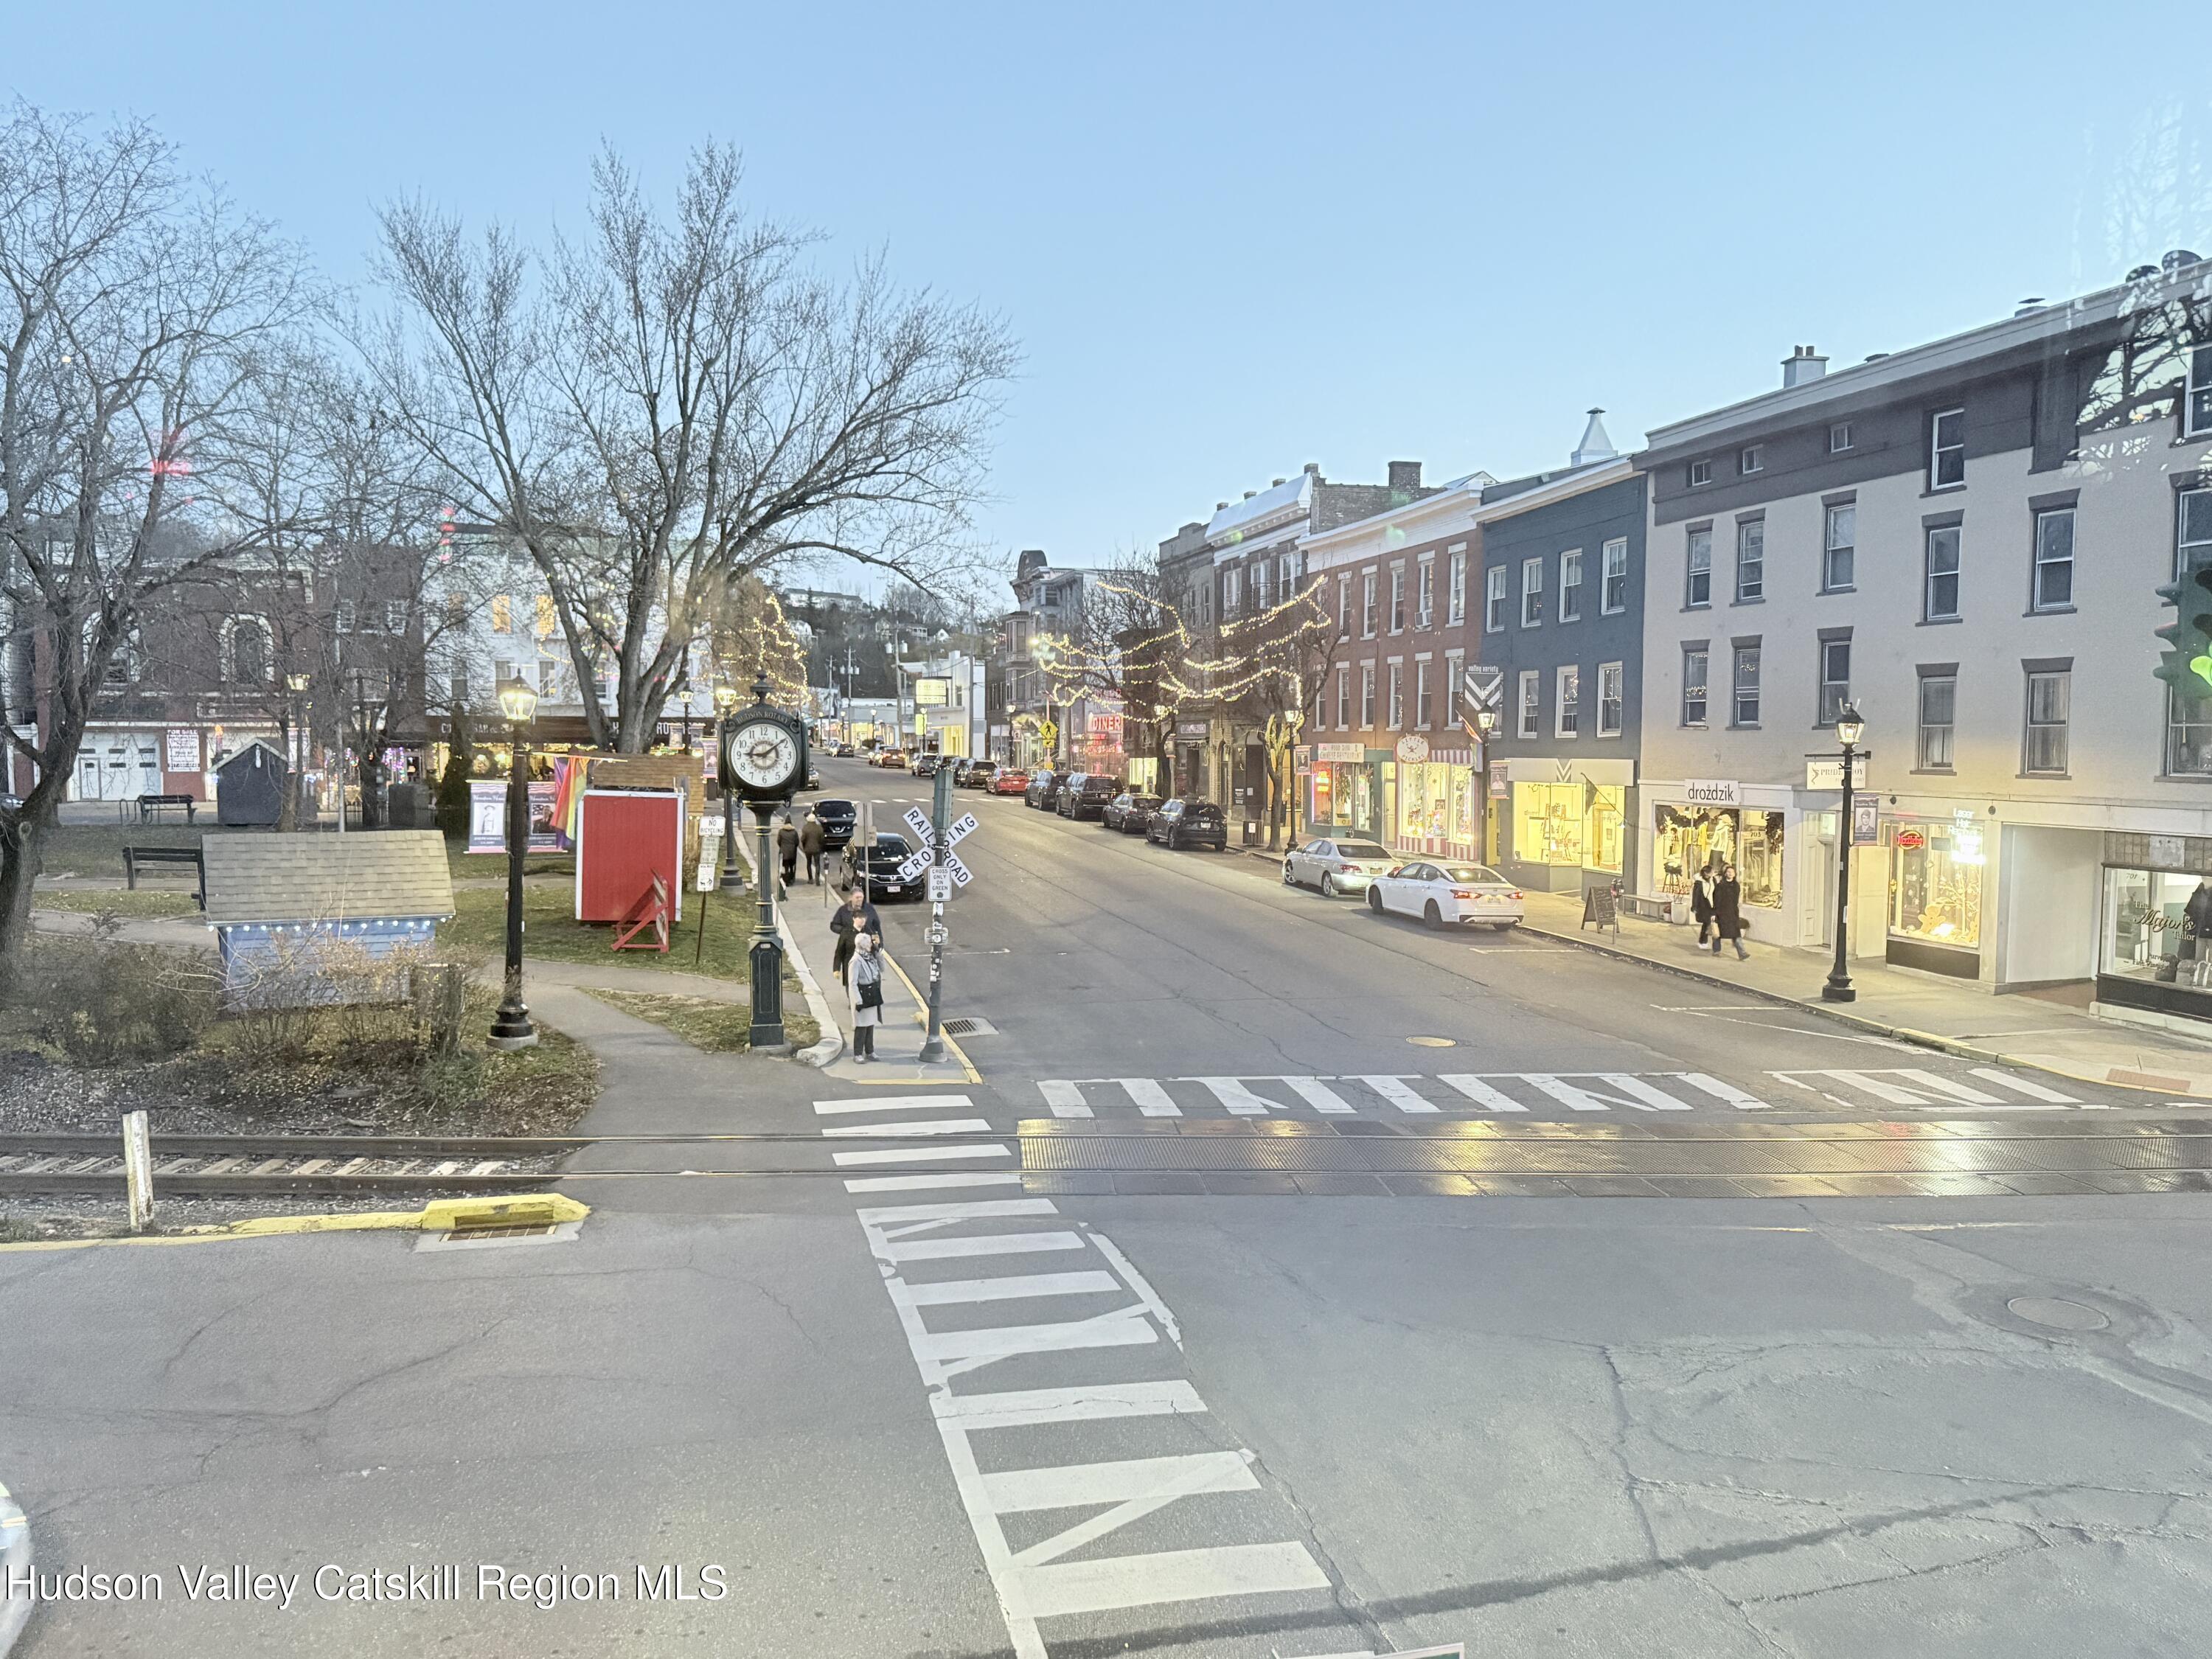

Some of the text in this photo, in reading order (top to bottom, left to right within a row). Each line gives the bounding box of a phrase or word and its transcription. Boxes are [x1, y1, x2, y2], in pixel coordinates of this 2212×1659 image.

[1469, 664, 1499, 673] valley variety
[737, 711, 790, 724] HUDSON ROTARY
[1092, 715, 1121, 731] DINER
[749, 730, 755, 740] 11
[760, 726, 768, 737] 12
[775, 731, 778, 740] 1
[740, 740, 747, 749] 10
[784, 740, 788, 748] 2
[737, 751, 742, 759] 9
[787, 751, 792, 760] 3
[740, 762, 745, 771] 8
[784, 762, 788, 771] 4
[749, 772, 754, 781] 7
[762, 775, 768, 784] 6
[775, 772, 780, 780] 5
[1952, 807, 1975, 818] Laser
[1955, 818, 1971, 827] Hair
[907, 810, 968, 883] RAIL ROAD
[2134, 900, 2149, 909] The
[2172, 930, 2196, 941] Tailor
